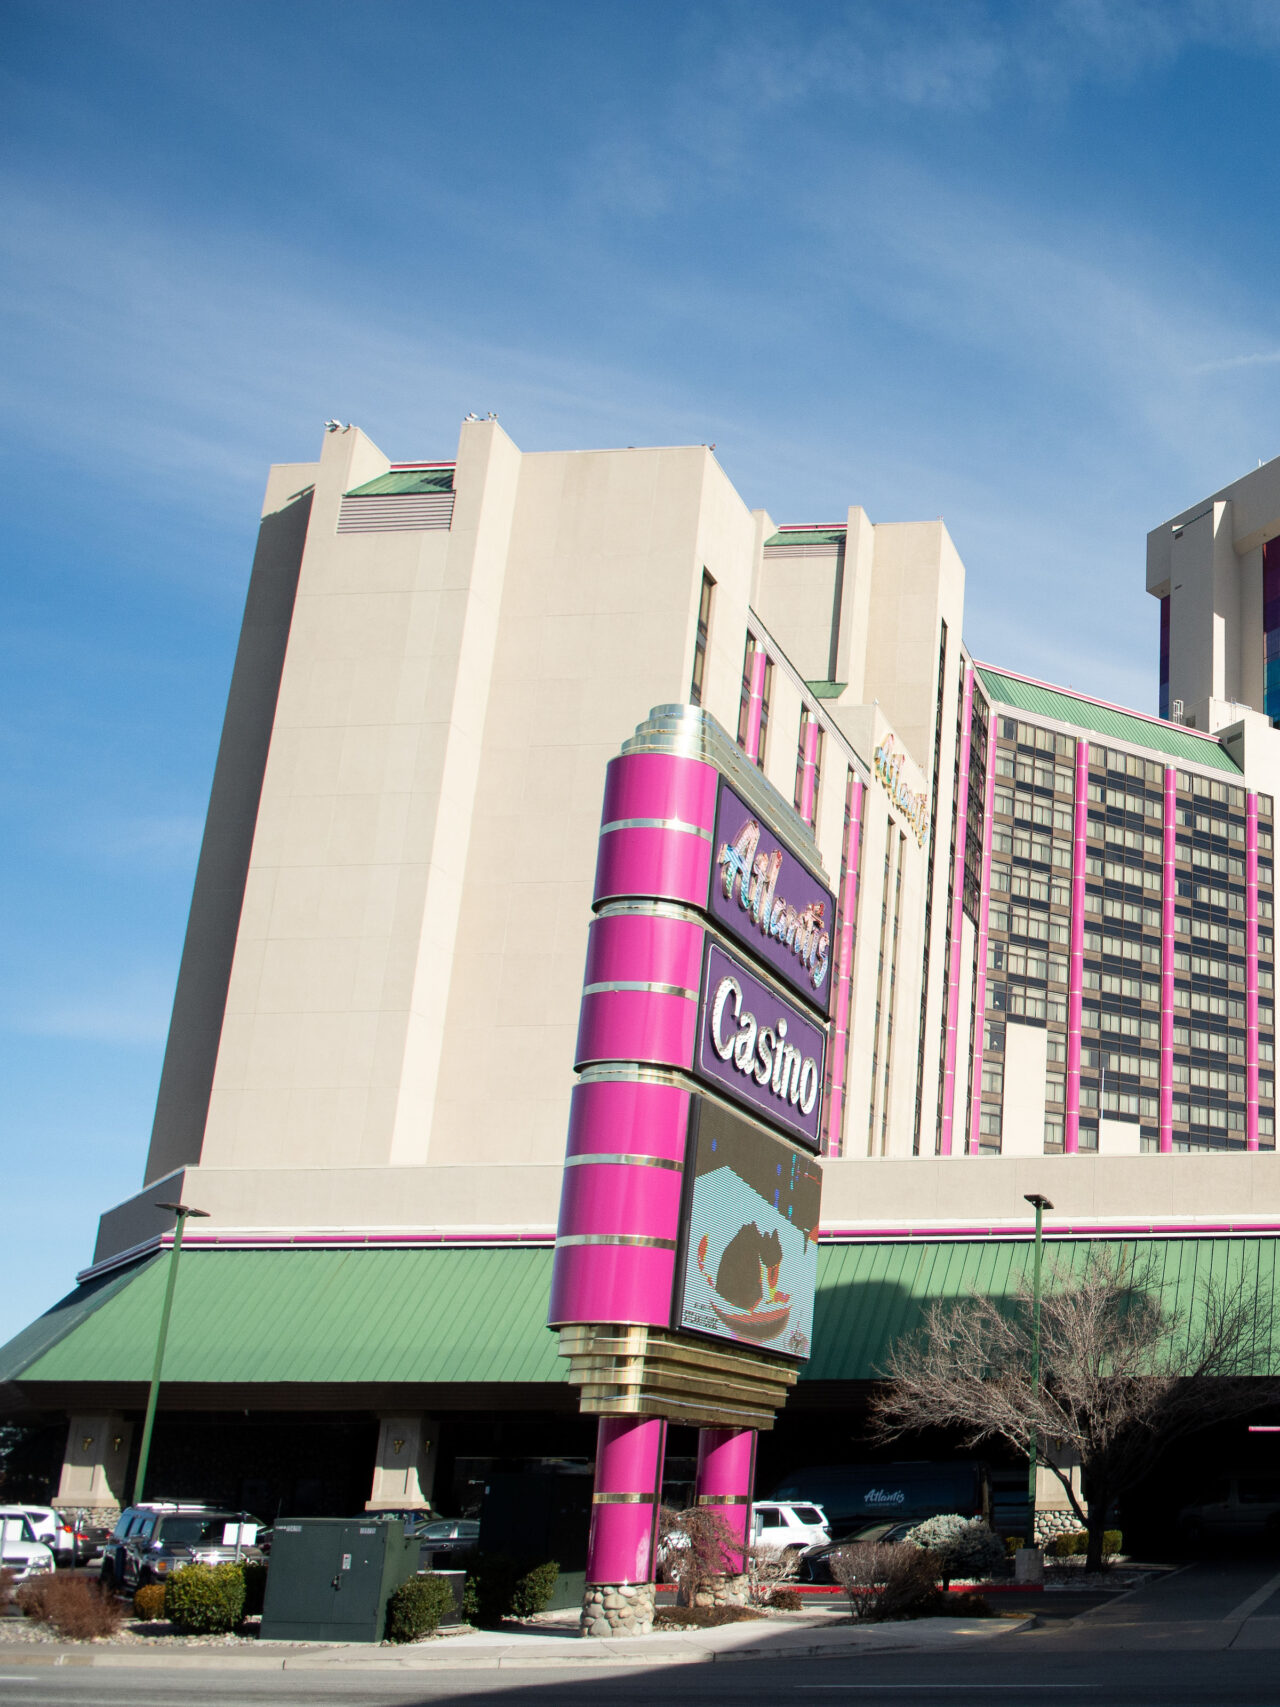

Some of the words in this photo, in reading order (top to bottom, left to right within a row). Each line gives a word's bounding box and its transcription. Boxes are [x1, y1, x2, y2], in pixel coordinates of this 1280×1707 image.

[716, 819, 830, 989] Atlantis
[711, 974, 819, 1116] Casino
[863, 1488, 905, 1504] Atlantis
